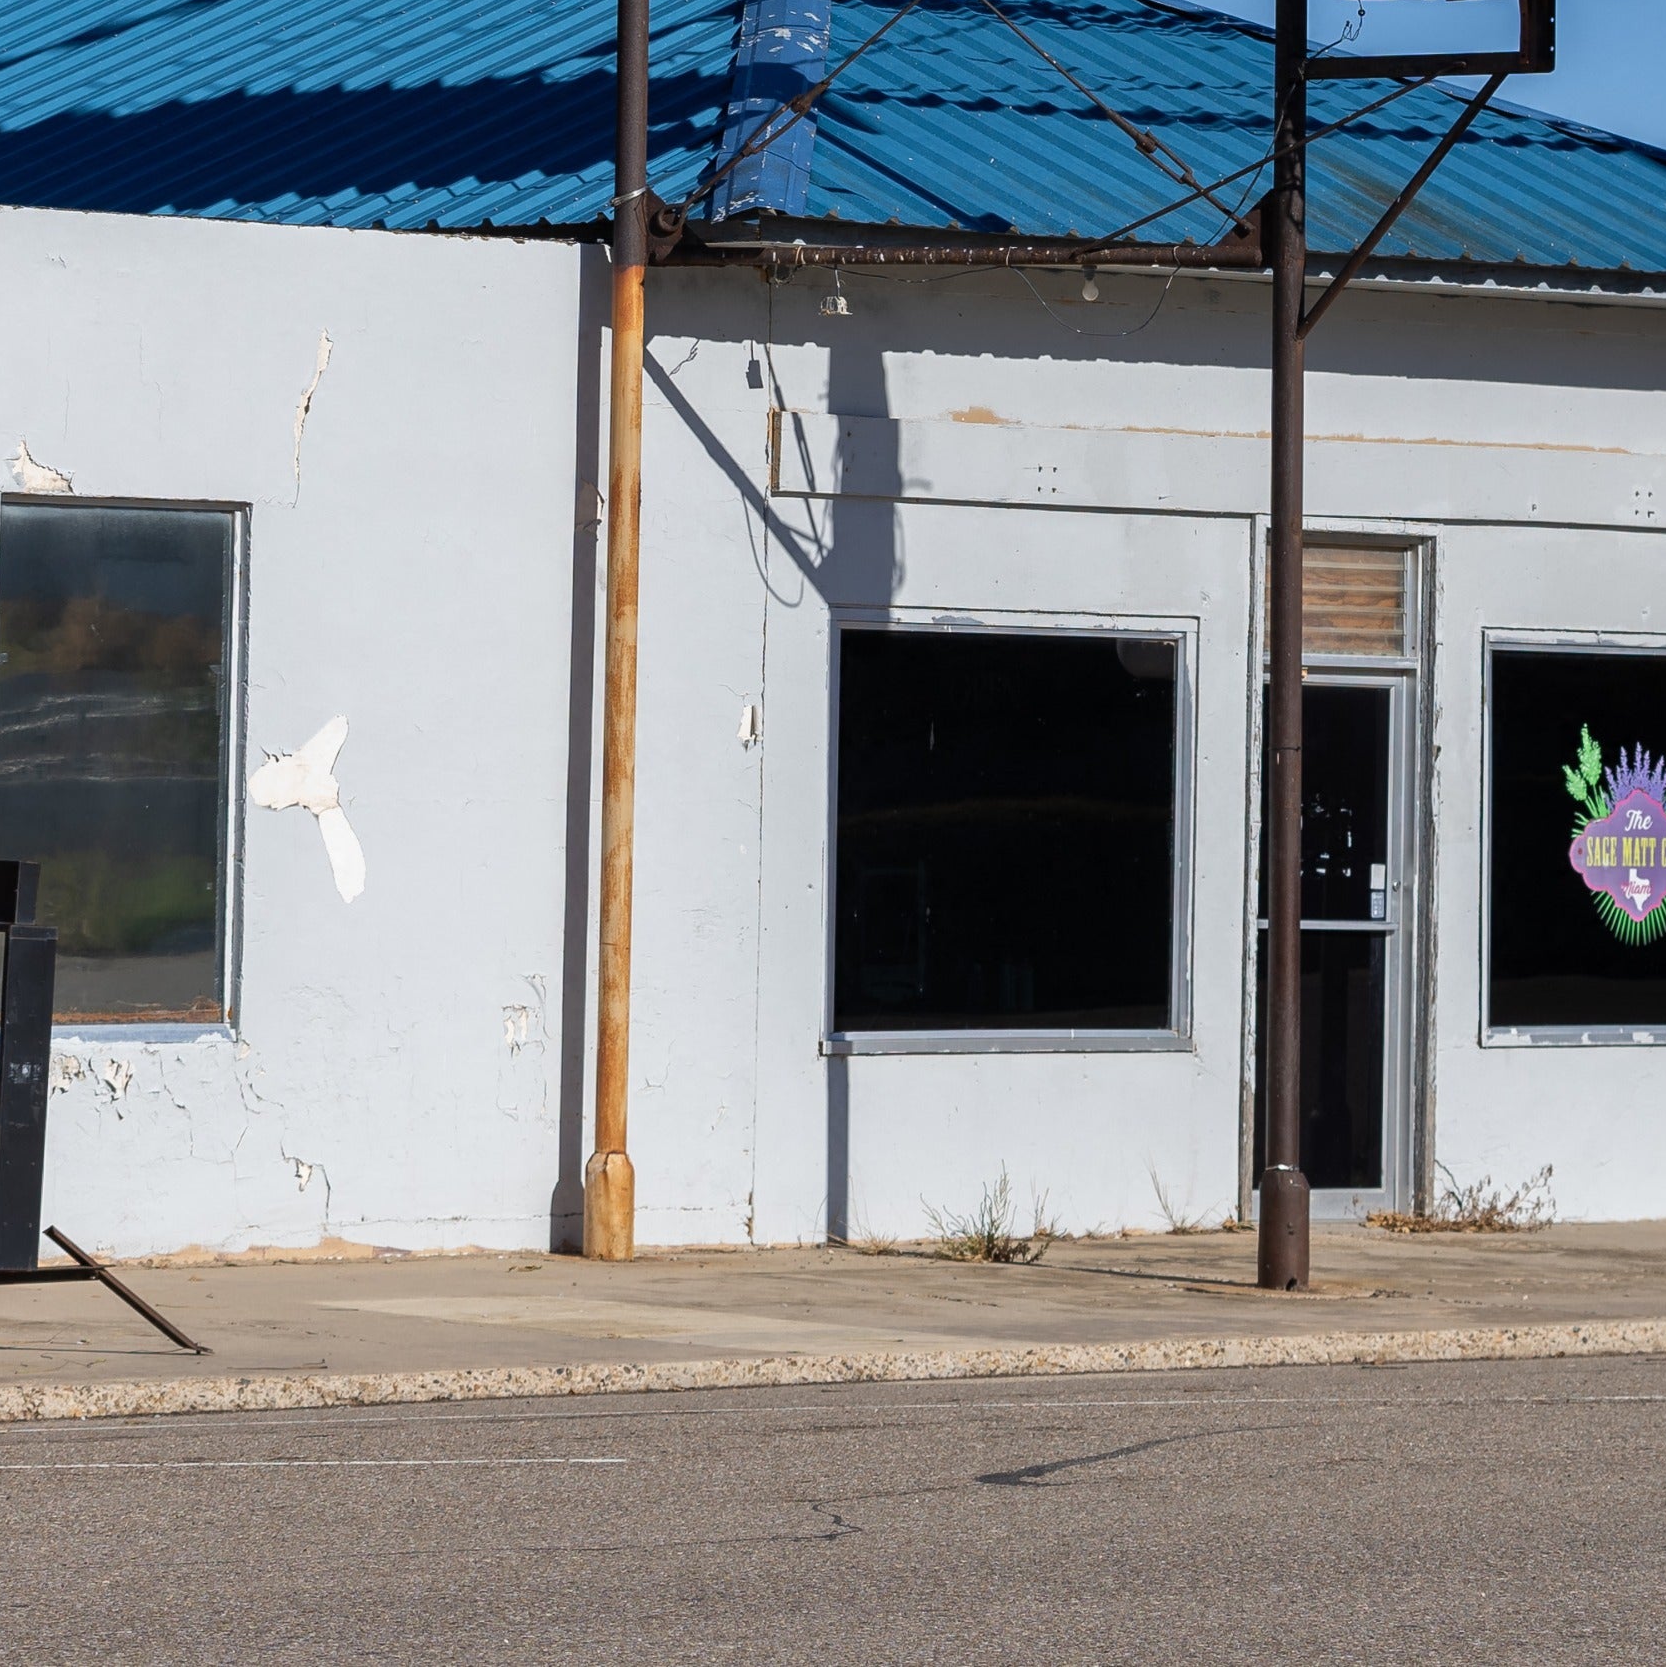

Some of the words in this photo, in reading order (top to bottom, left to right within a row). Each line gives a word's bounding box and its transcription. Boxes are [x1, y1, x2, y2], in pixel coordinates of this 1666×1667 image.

[1623, 809, 1653, 832] The
[1586, 836, 1617, 868] SAGE
[1622, 836, 1656, 868] MATT
[1621, 880, 1655, 896] Miam
